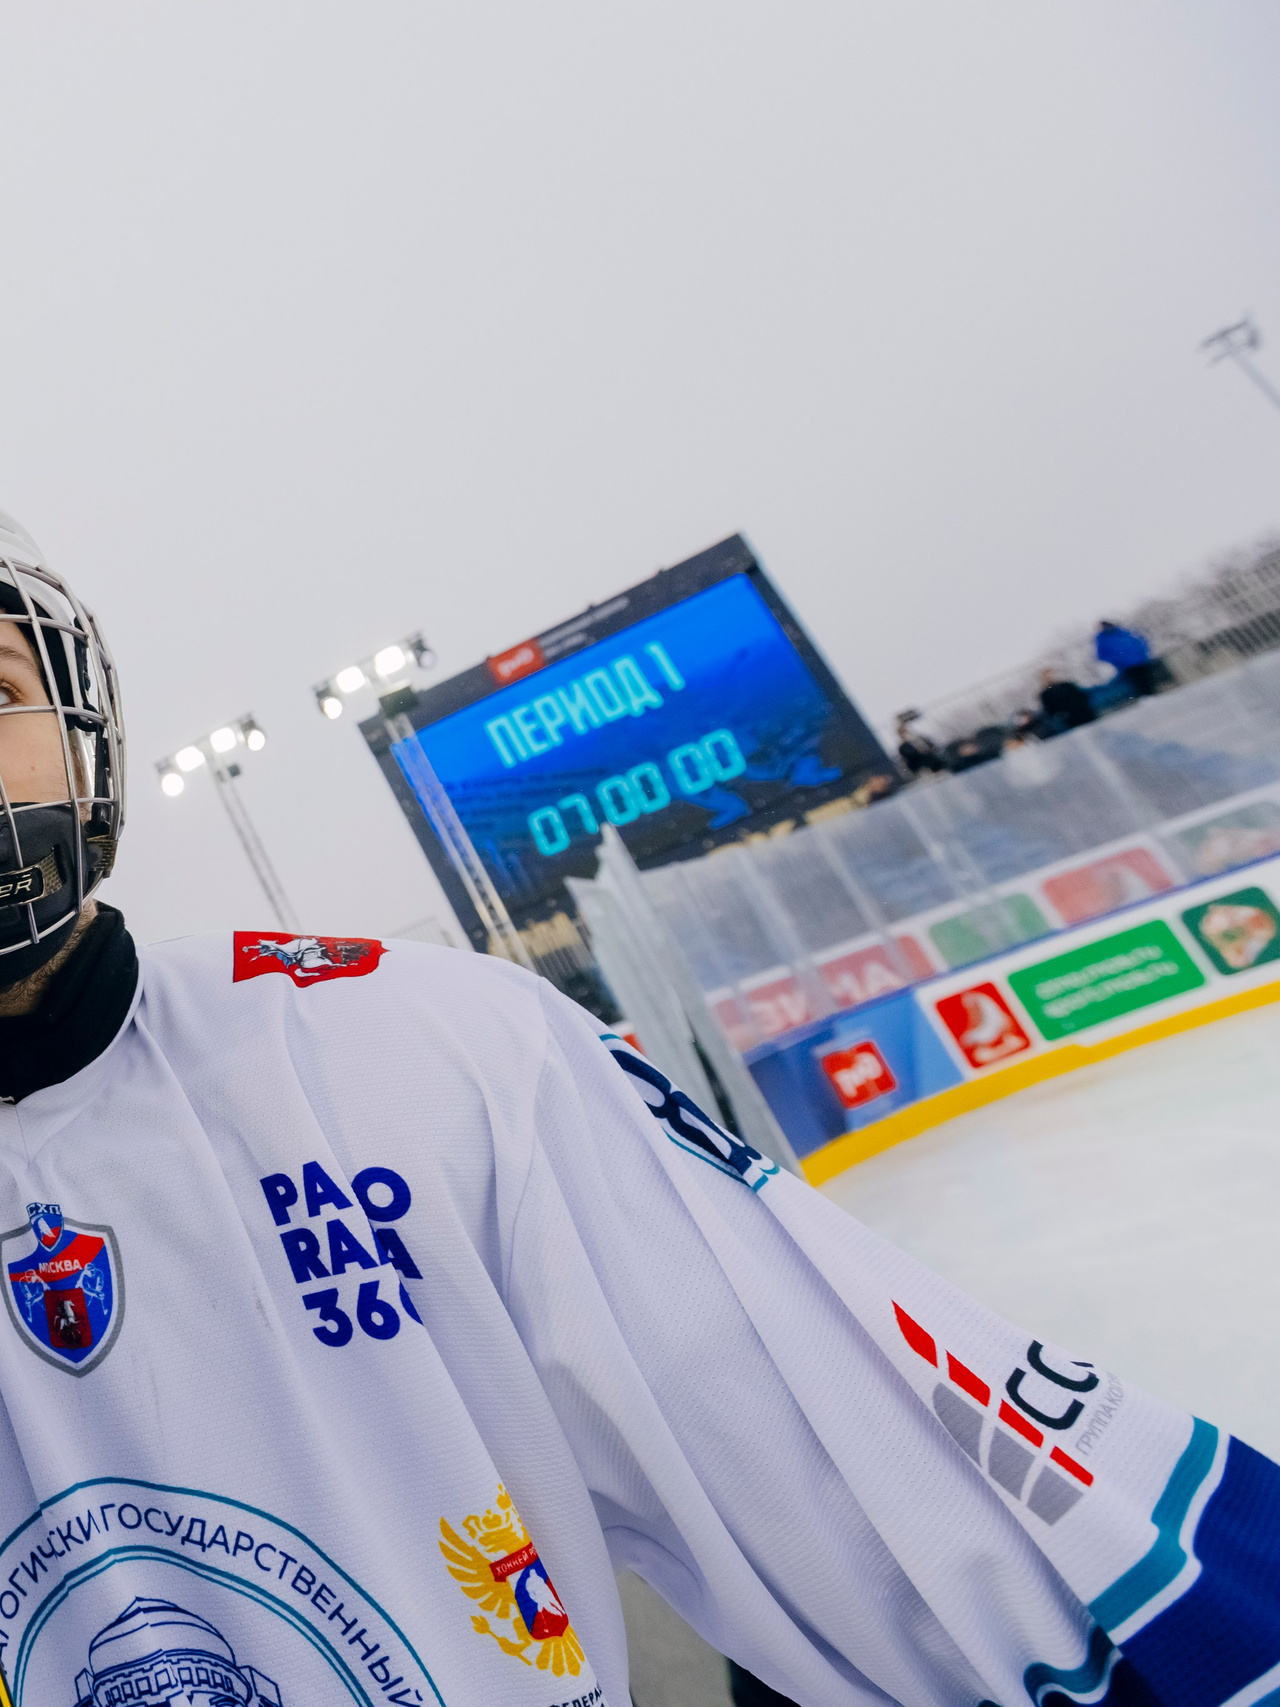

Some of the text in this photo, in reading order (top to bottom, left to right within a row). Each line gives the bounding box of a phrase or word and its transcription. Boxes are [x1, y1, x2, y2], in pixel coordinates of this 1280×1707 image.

[484, 640, 686, 768] ПЕРИОД 1
[26, 1203, 61, 1216] СХП
[260, 1160, 412, 1226] PAO
[280, 1219, 424, 1284] RAA
